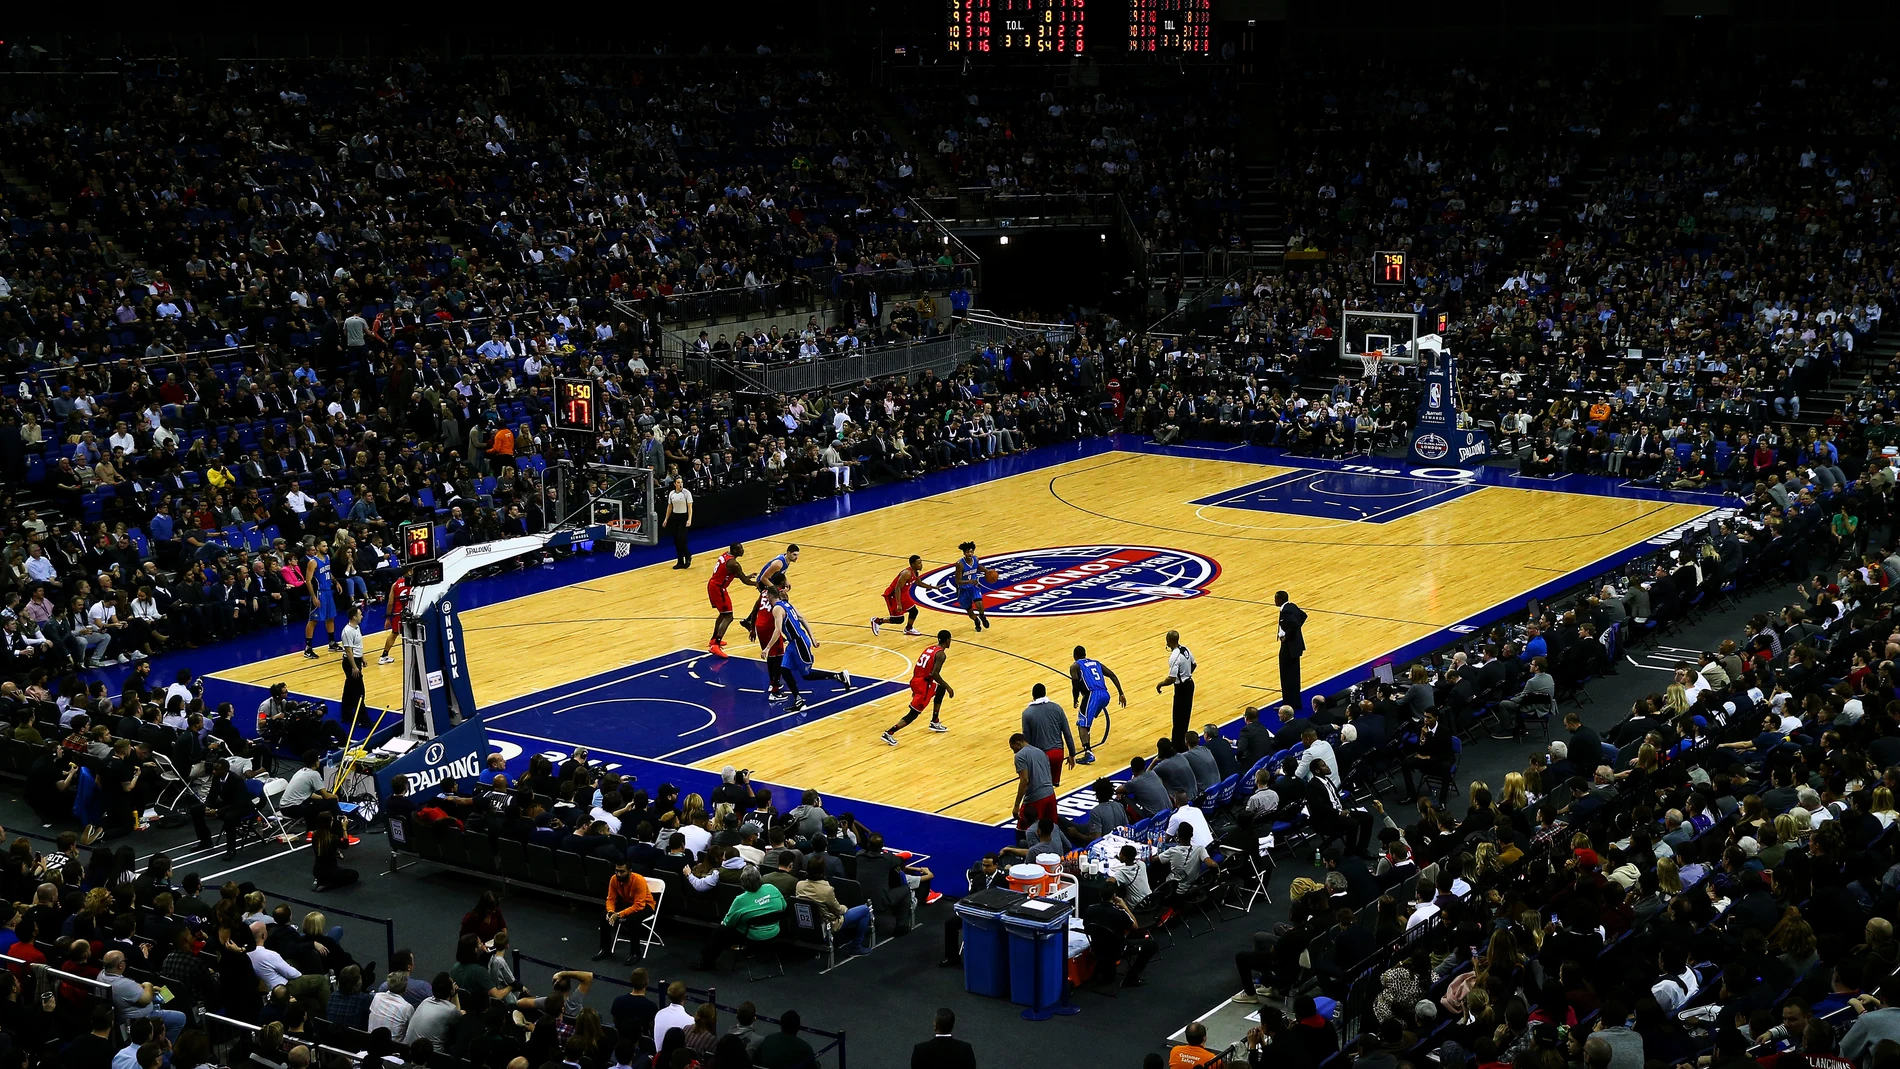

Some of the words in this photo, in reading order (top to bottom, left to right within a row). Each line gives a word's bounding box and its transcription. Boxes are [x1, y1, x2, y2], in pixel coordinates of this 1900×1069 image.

[953, 10, 960, 22] 9
[965, 11, 972, 23] 2
[979, 11, 990, 23] 10
[1045, 10, 1052, 22] 8
[949, 25, 960, 37] 10
[966, 25, 972, 37] 3
[979, 26, 990, 37] 14
[1006, 20, 1024, 30] T.O.L.
[1038, 25, 1052, 37] 31
[1058, 25, 1065, 37] 2
[1076, 25, 1084, 37] 2
[949, 40, 960, 51] 14
[979, 40, 990, 52] 16
[1005, 35, 1012, 47] 3
[1024, 35, 1031, 47] 3
[1038, 40, 1052, 52] 54
[1058, 40, 1065, 52] 2
[1076, 40, 1084, 52] 8
[1384, 255, 1403, 264] 7:50
[1386, 265, 1400, 280] 17
[567, 384, 590, 399] 7:50
[570, 400, 588, 424] 17
[1458, 440, 1486, 463] SPALDING
[1340, 464, 1401, 475] The
[410, 527, 429, 541] 7:50
[410, 540, 426, 556] 17
[465, 544, 492, 556] SPALDING
[1131, 555, 1181, 569] NBA
[986, 558, 1131, 600] LONDON
[1063, 567, 1142, 590] GLOBAL
[760, 598, 772, 613] 54
[999, 589, 1073, 612] GAMES
[441, 600, 460, 680] @NBAUK
[916, 653, 931, 669] 31
[1090, 668, 1101, 681] 5
[404, 751, 480, 797] PALDING
[1029, 886, 1038, 894] G
[800, 914, 810, 922] D2
[1179, 1052, 1201, 1061] Customer
[1181, 1057, 1196, 1065] Safety
